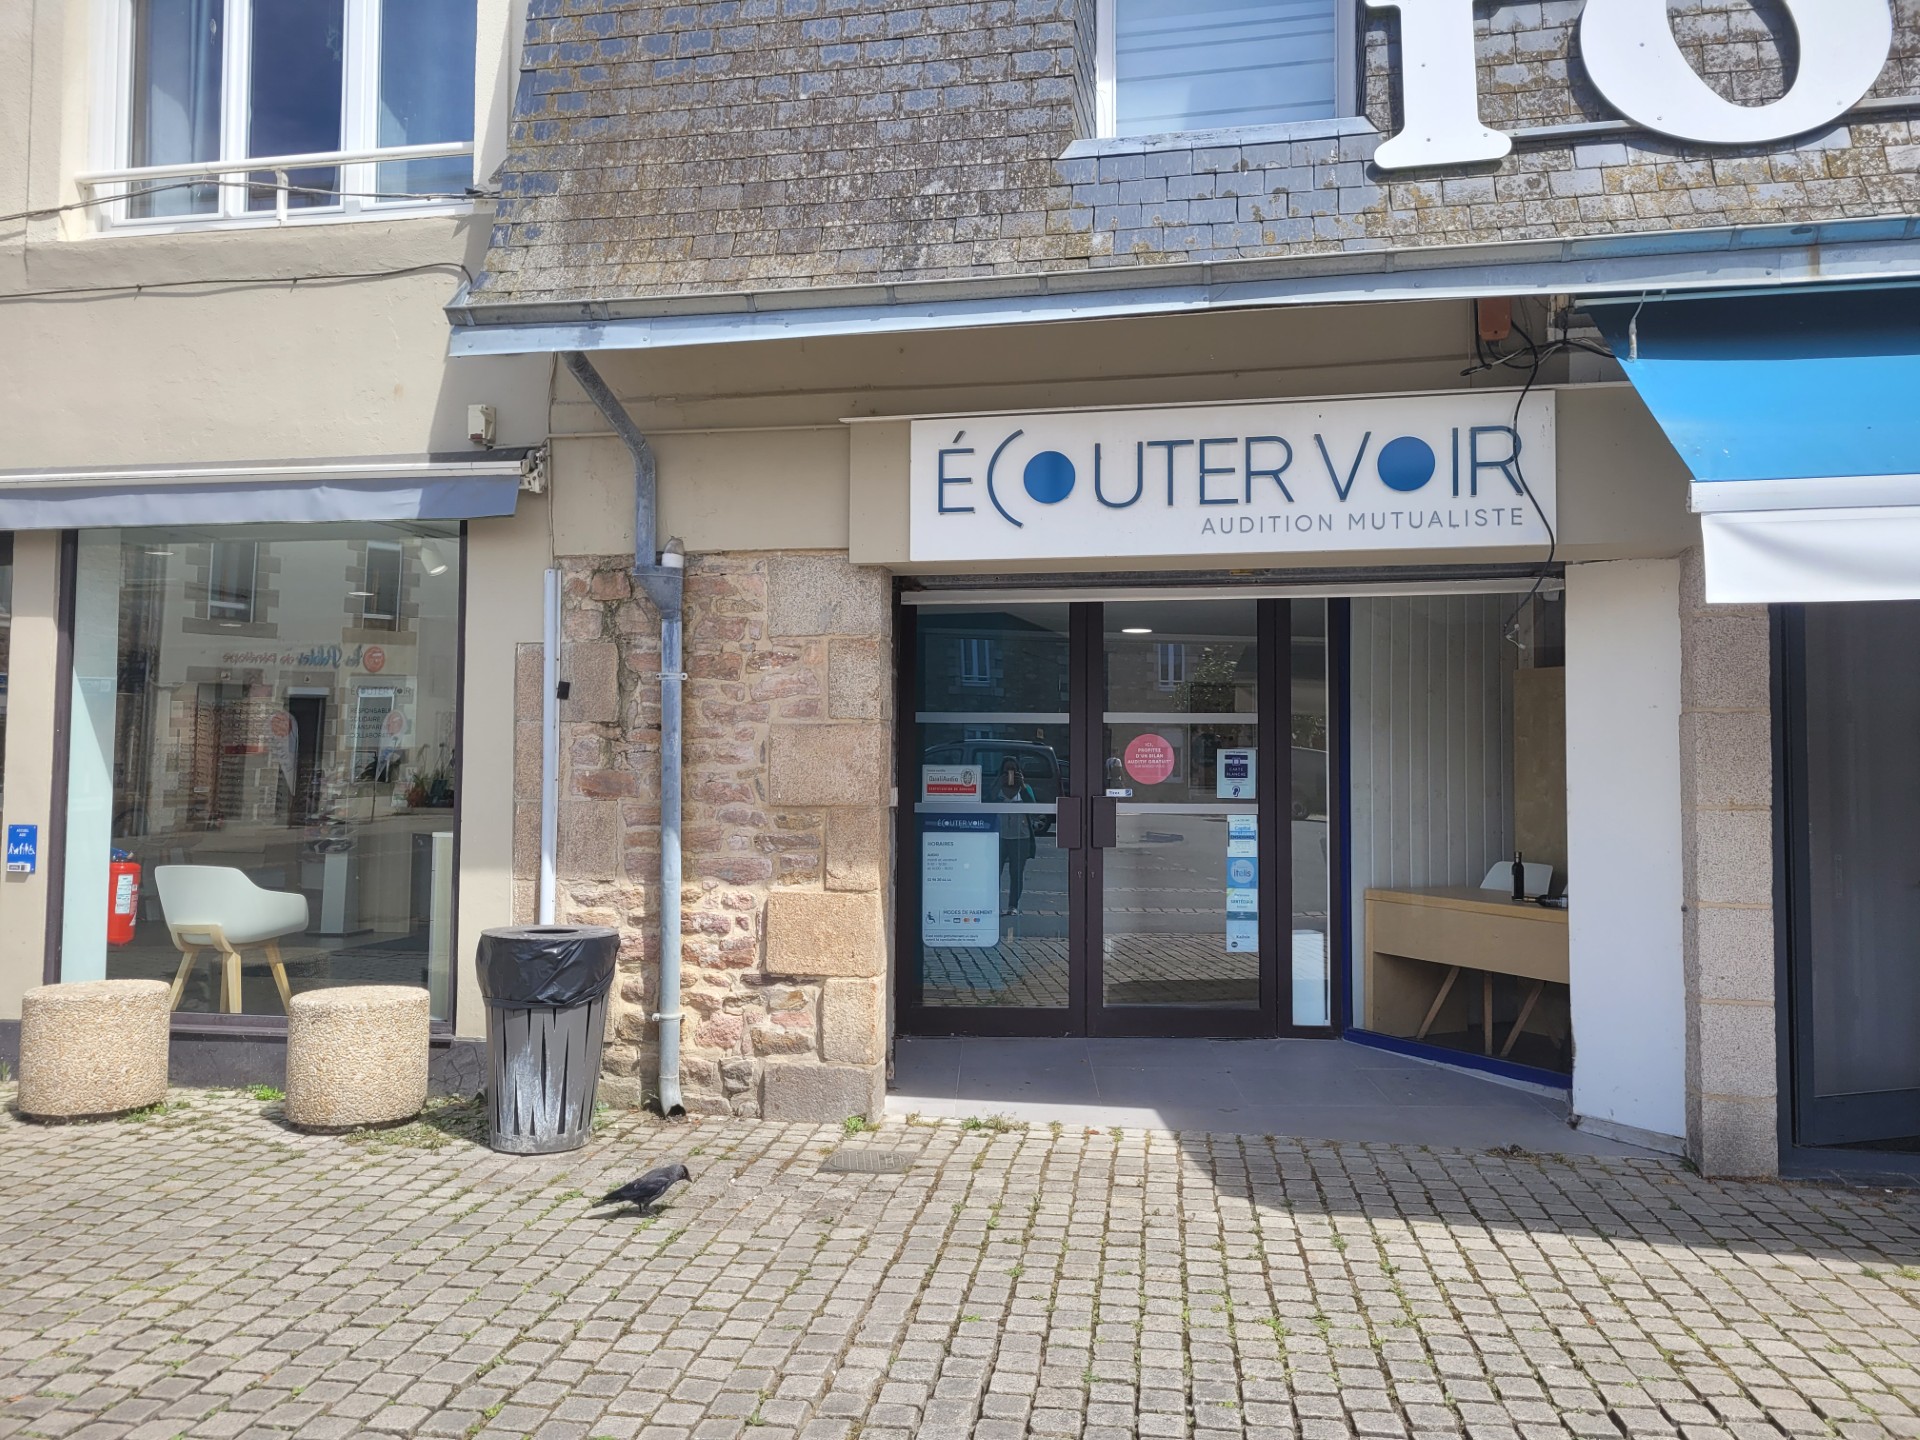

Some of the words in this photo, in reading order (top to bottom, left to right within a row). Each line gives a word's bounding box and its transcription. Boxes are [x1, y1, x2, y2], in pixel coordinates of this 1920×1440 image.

[937, 428, 1294, 529] ÉCOUTER
[1313, 424, 1524, 503] VOIR
[1201, 511, 1333, 535] AUDITION
[1348, 506, 1524, 531] MUTUALISTE
